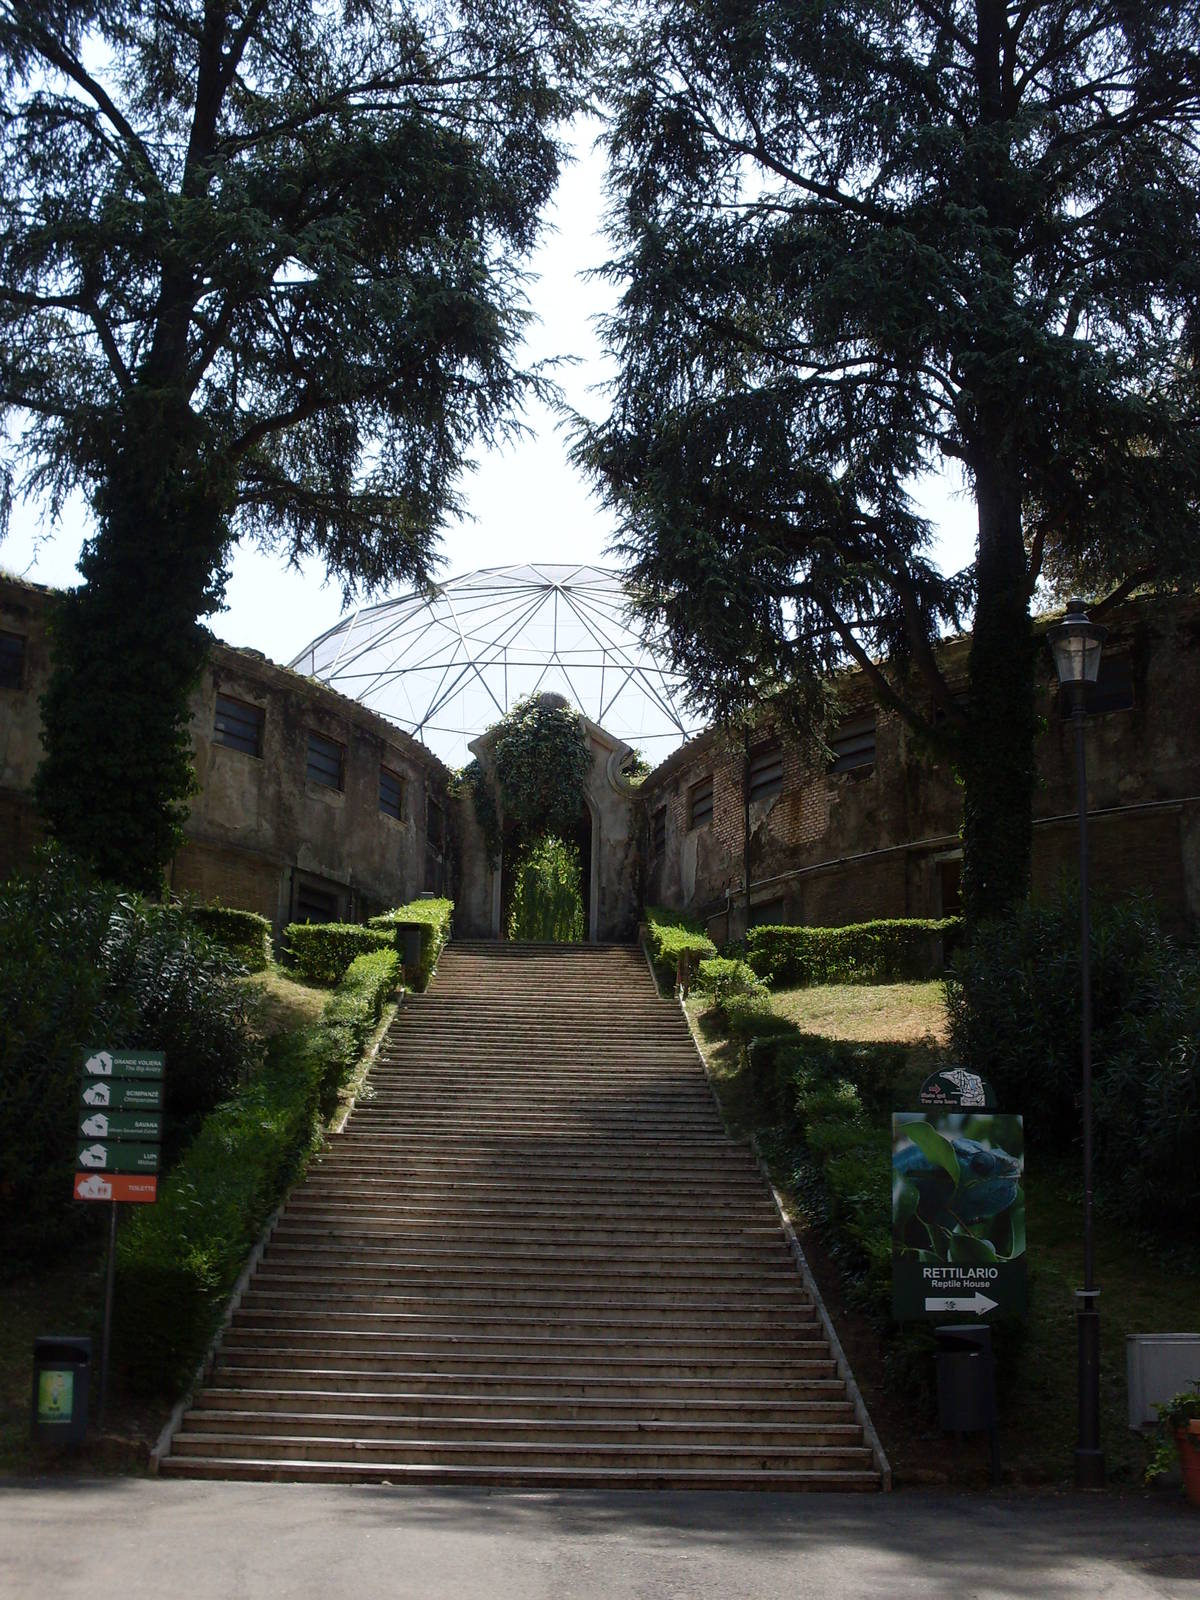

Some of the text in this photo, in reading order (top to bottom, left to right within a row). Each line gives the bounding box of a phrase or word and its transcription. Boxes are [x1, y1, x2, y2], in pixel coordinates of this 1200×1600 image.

[923, 1267, 998, 1279] RETTILARIO
[931, 1280, 990, 1288] Reptile House
